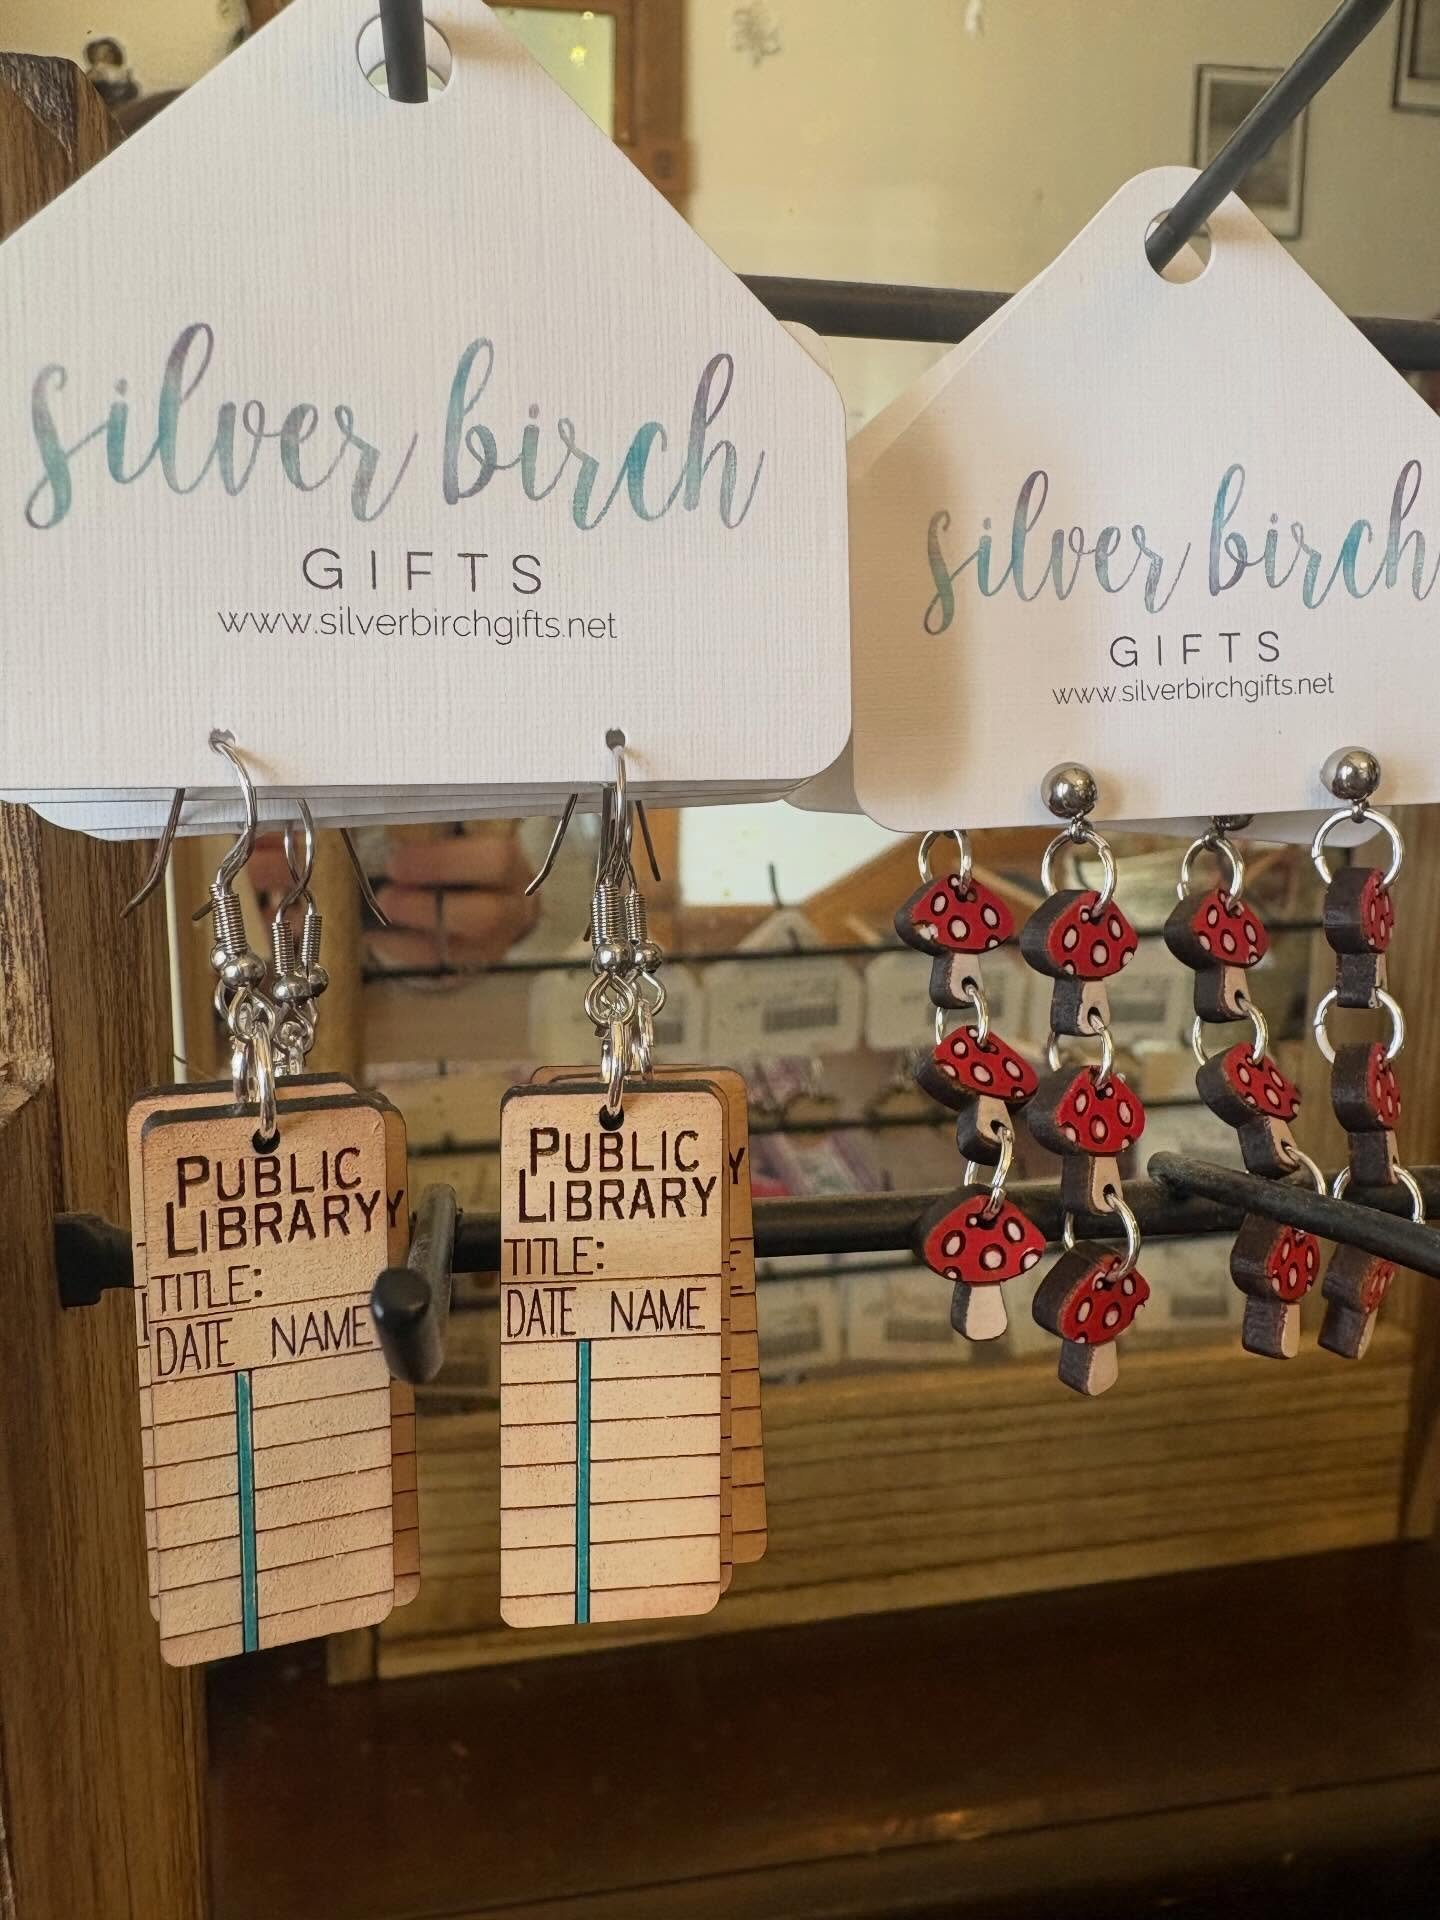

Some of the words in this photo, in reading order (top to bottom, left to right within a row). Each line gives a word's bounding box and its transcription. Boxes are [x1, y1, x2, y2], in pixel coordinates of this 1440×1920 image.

[24, 322, 419, 530] silver
[442, 336, 766, 531] birch
[301, 547, 544, 595] GIFTS
[923, 469, 1192, 636] silver
[1208, 458, 1440, 610] birch
[217, 606, 619, 646] www.silverbirchgifts.net
[1109, 630, 1281, 668] GIFTS
[1051, 671, 1336, 705] www.silverbirchgifts.net
[529, 1126, 700, 1177] PUBLIC
[175, 1146, 362, 1209] PUBLIC
[518, 1168, 717, 1223] LIBRARY
[165, 1189, 381, 1259] LIBRARY
[503, 1236, 605, 1276] TITLE:
[150, 1263, 263, 1314] TITLE:
[506, 1286, 577, 1338] DATE
[610, 1286, 707, 1333] NAME
[156, 1317, 235, 1377] DATE
[271, 1303, 373, 1359] NAME
